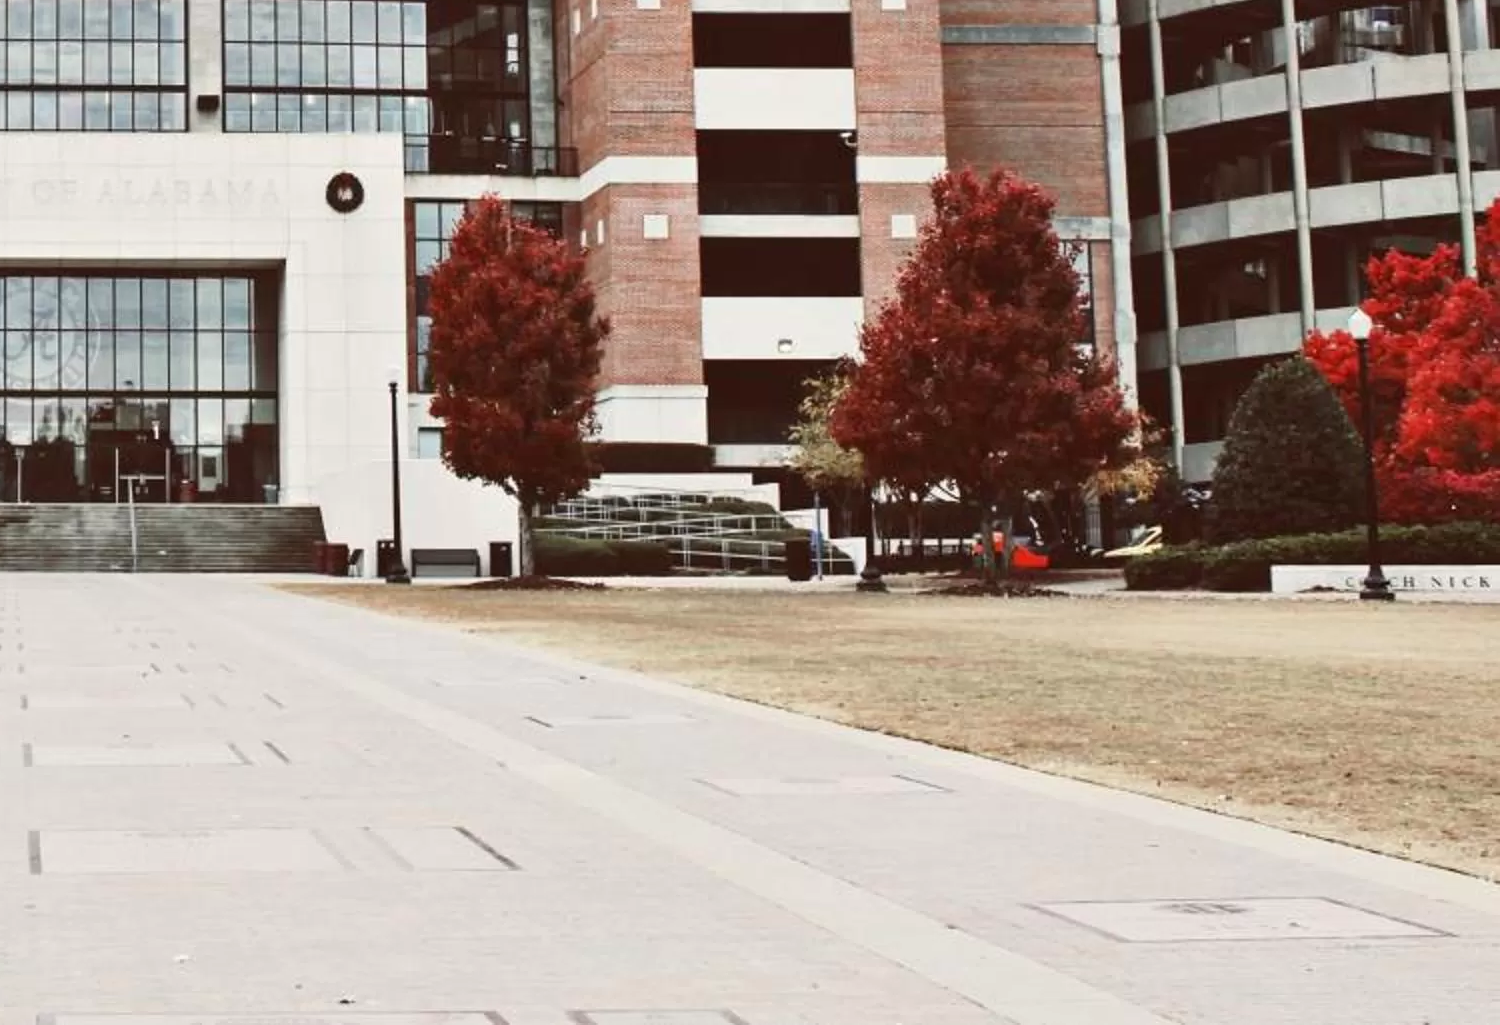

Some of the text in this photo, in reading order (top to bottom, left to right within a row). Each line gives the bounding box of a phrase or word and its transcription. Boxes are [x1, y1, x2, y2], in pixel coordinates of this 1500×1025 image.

[31, 179, 78, 205] OF
[97, 178, 280, 205] ALABAMA
[1345, 576, 1491, 588] CCH NICK
